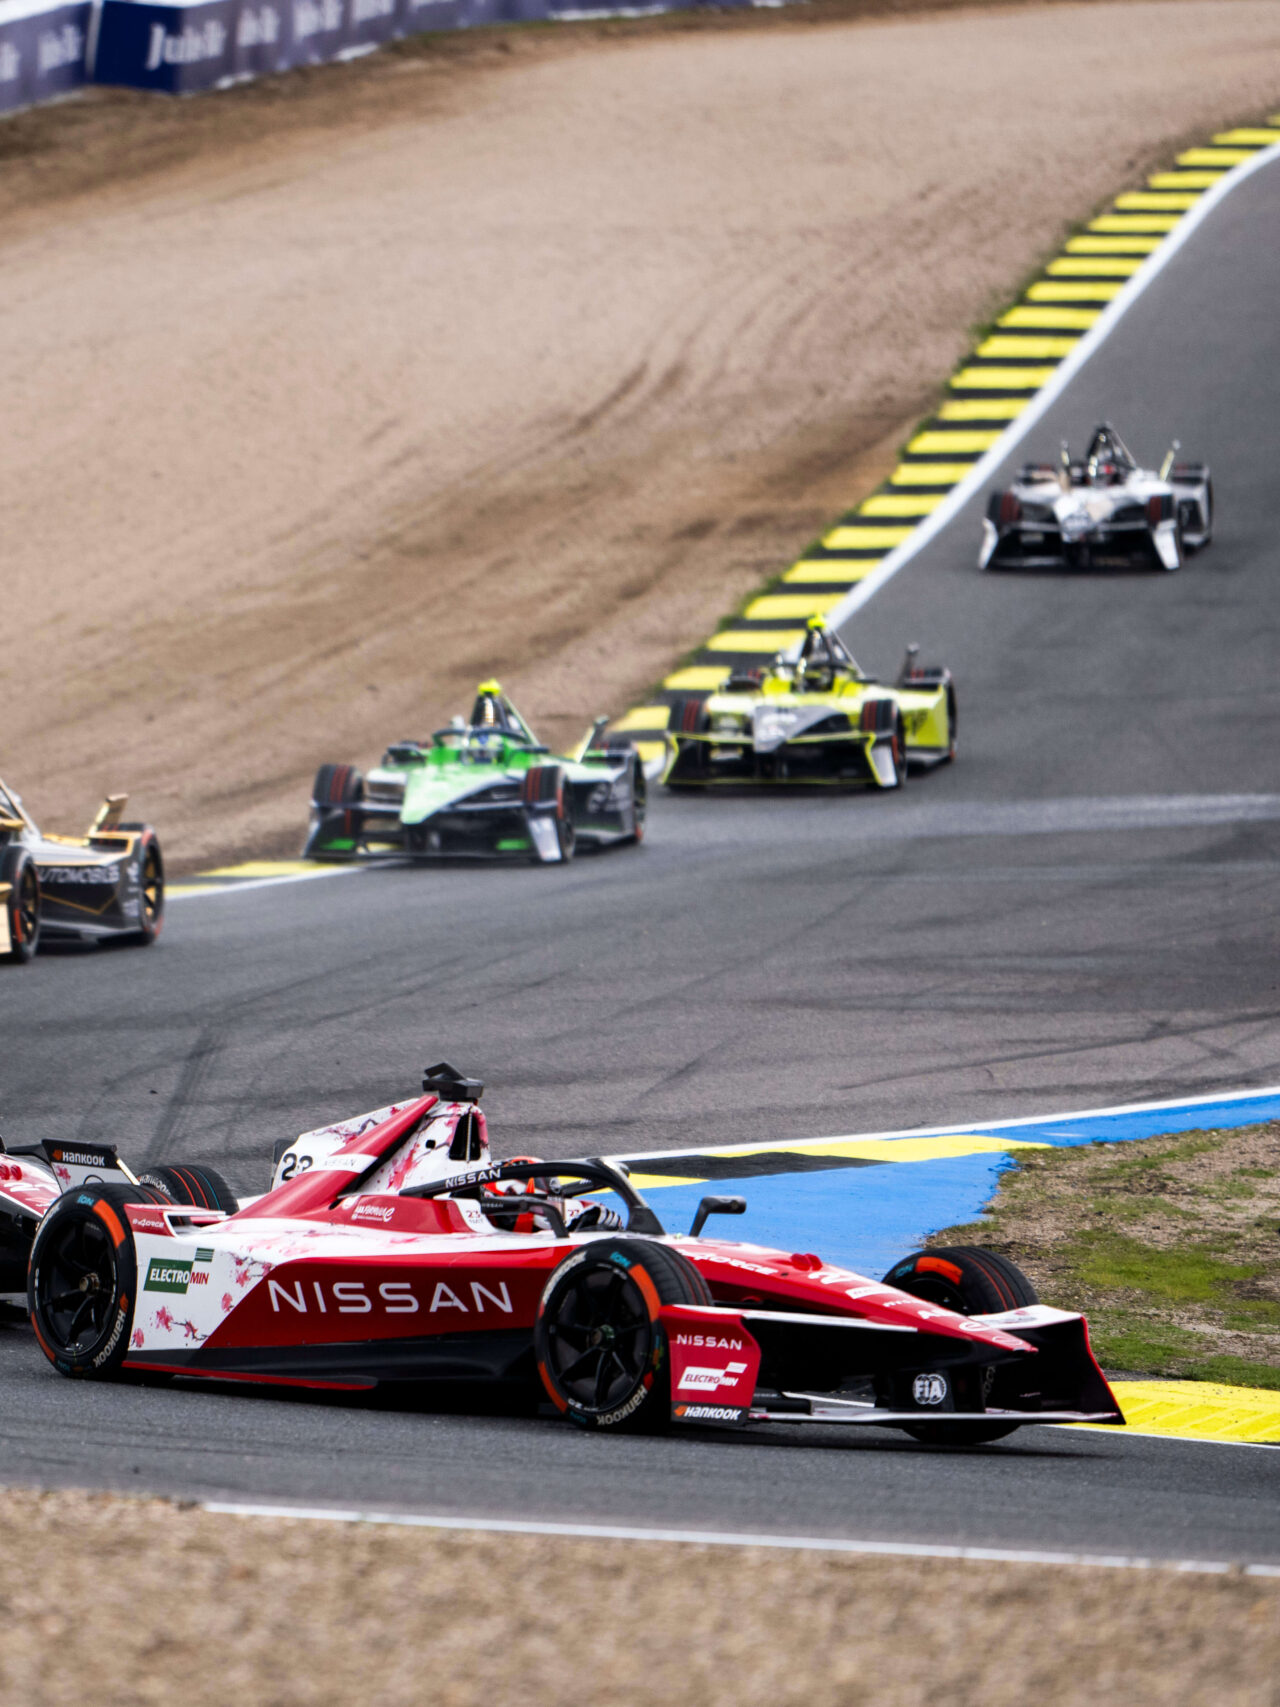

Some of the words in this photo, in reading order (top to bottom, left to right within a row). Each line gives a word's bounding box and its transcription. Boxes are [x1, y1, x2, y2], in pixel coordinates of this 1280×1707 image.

[445, 1168, 502, 1189] NISSAN
[267, 1279, 514, 1313] NISSAN
[676, 1333, 743, 1351] NISSAN
[915, 1378, 942, 1400] FIA
